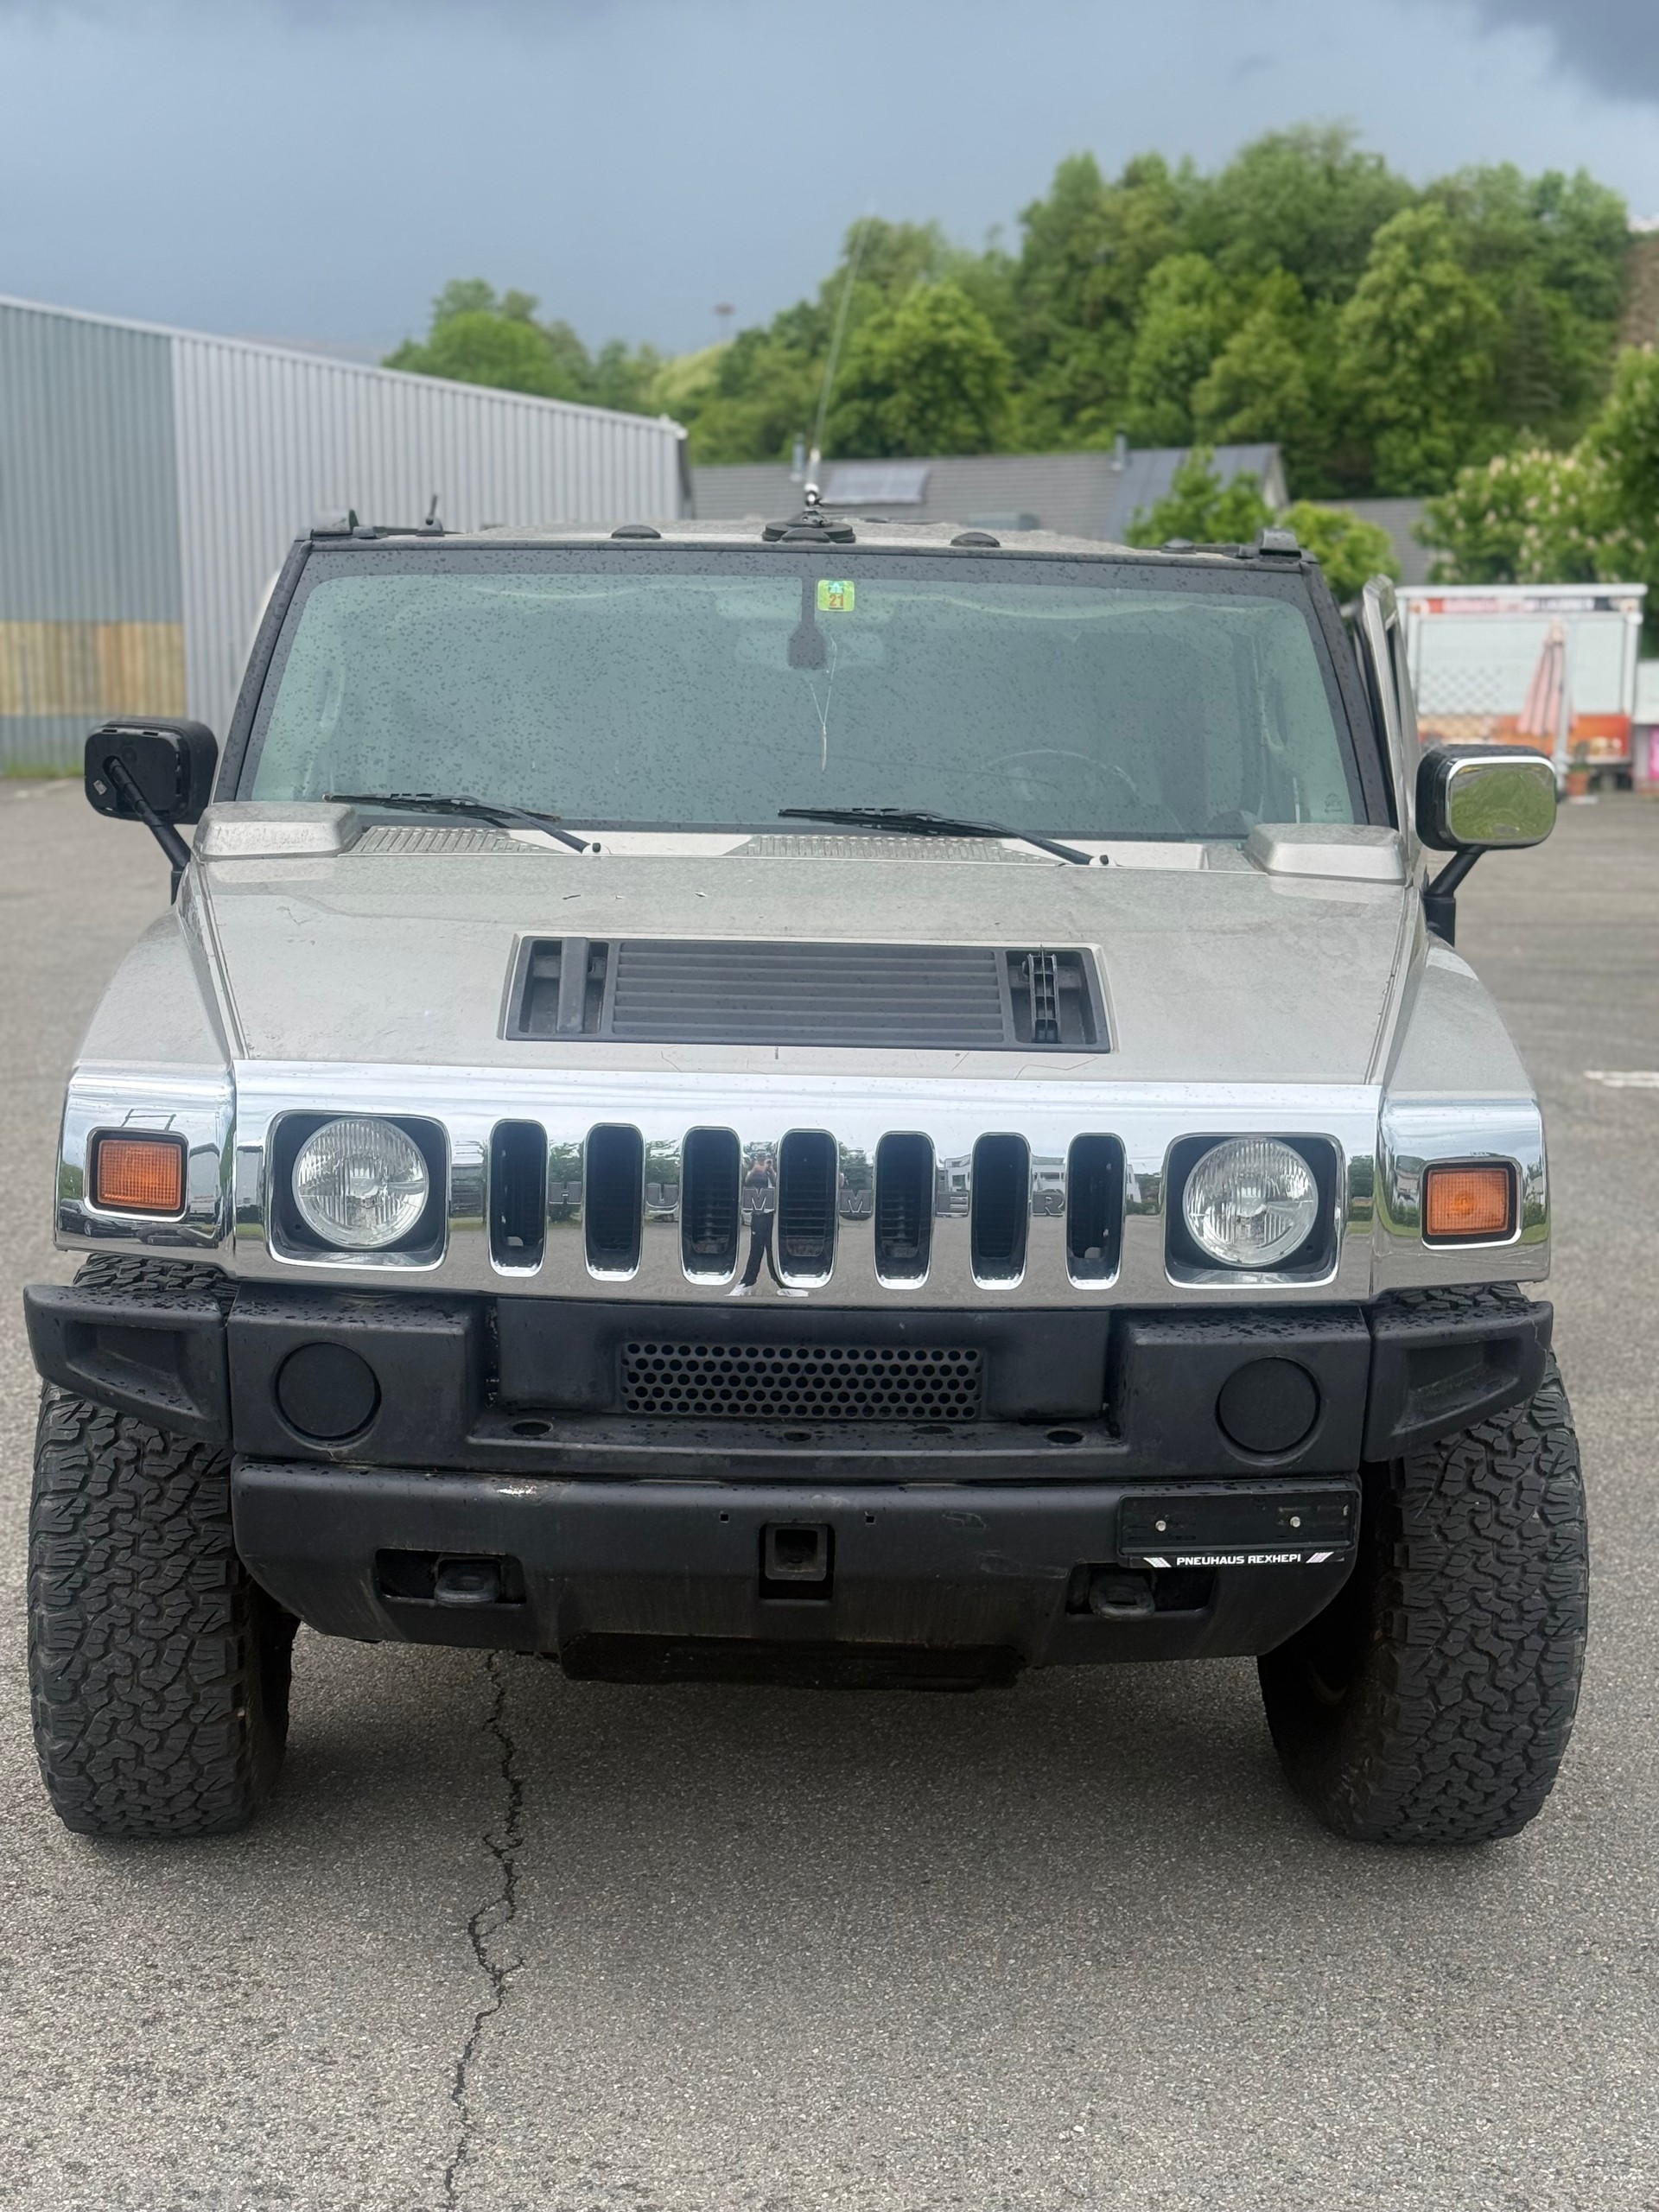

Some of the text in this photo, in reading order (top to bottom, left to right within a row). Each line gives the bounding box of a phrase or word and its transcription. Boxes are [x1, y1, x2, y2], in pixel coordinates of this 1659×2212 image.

[830, 594, 843, 607] 21
[549, 1181, 1065, 1217] HUMMER
[1176, 1554, 1301, 1566] PNEUHAUS REXHEPI
